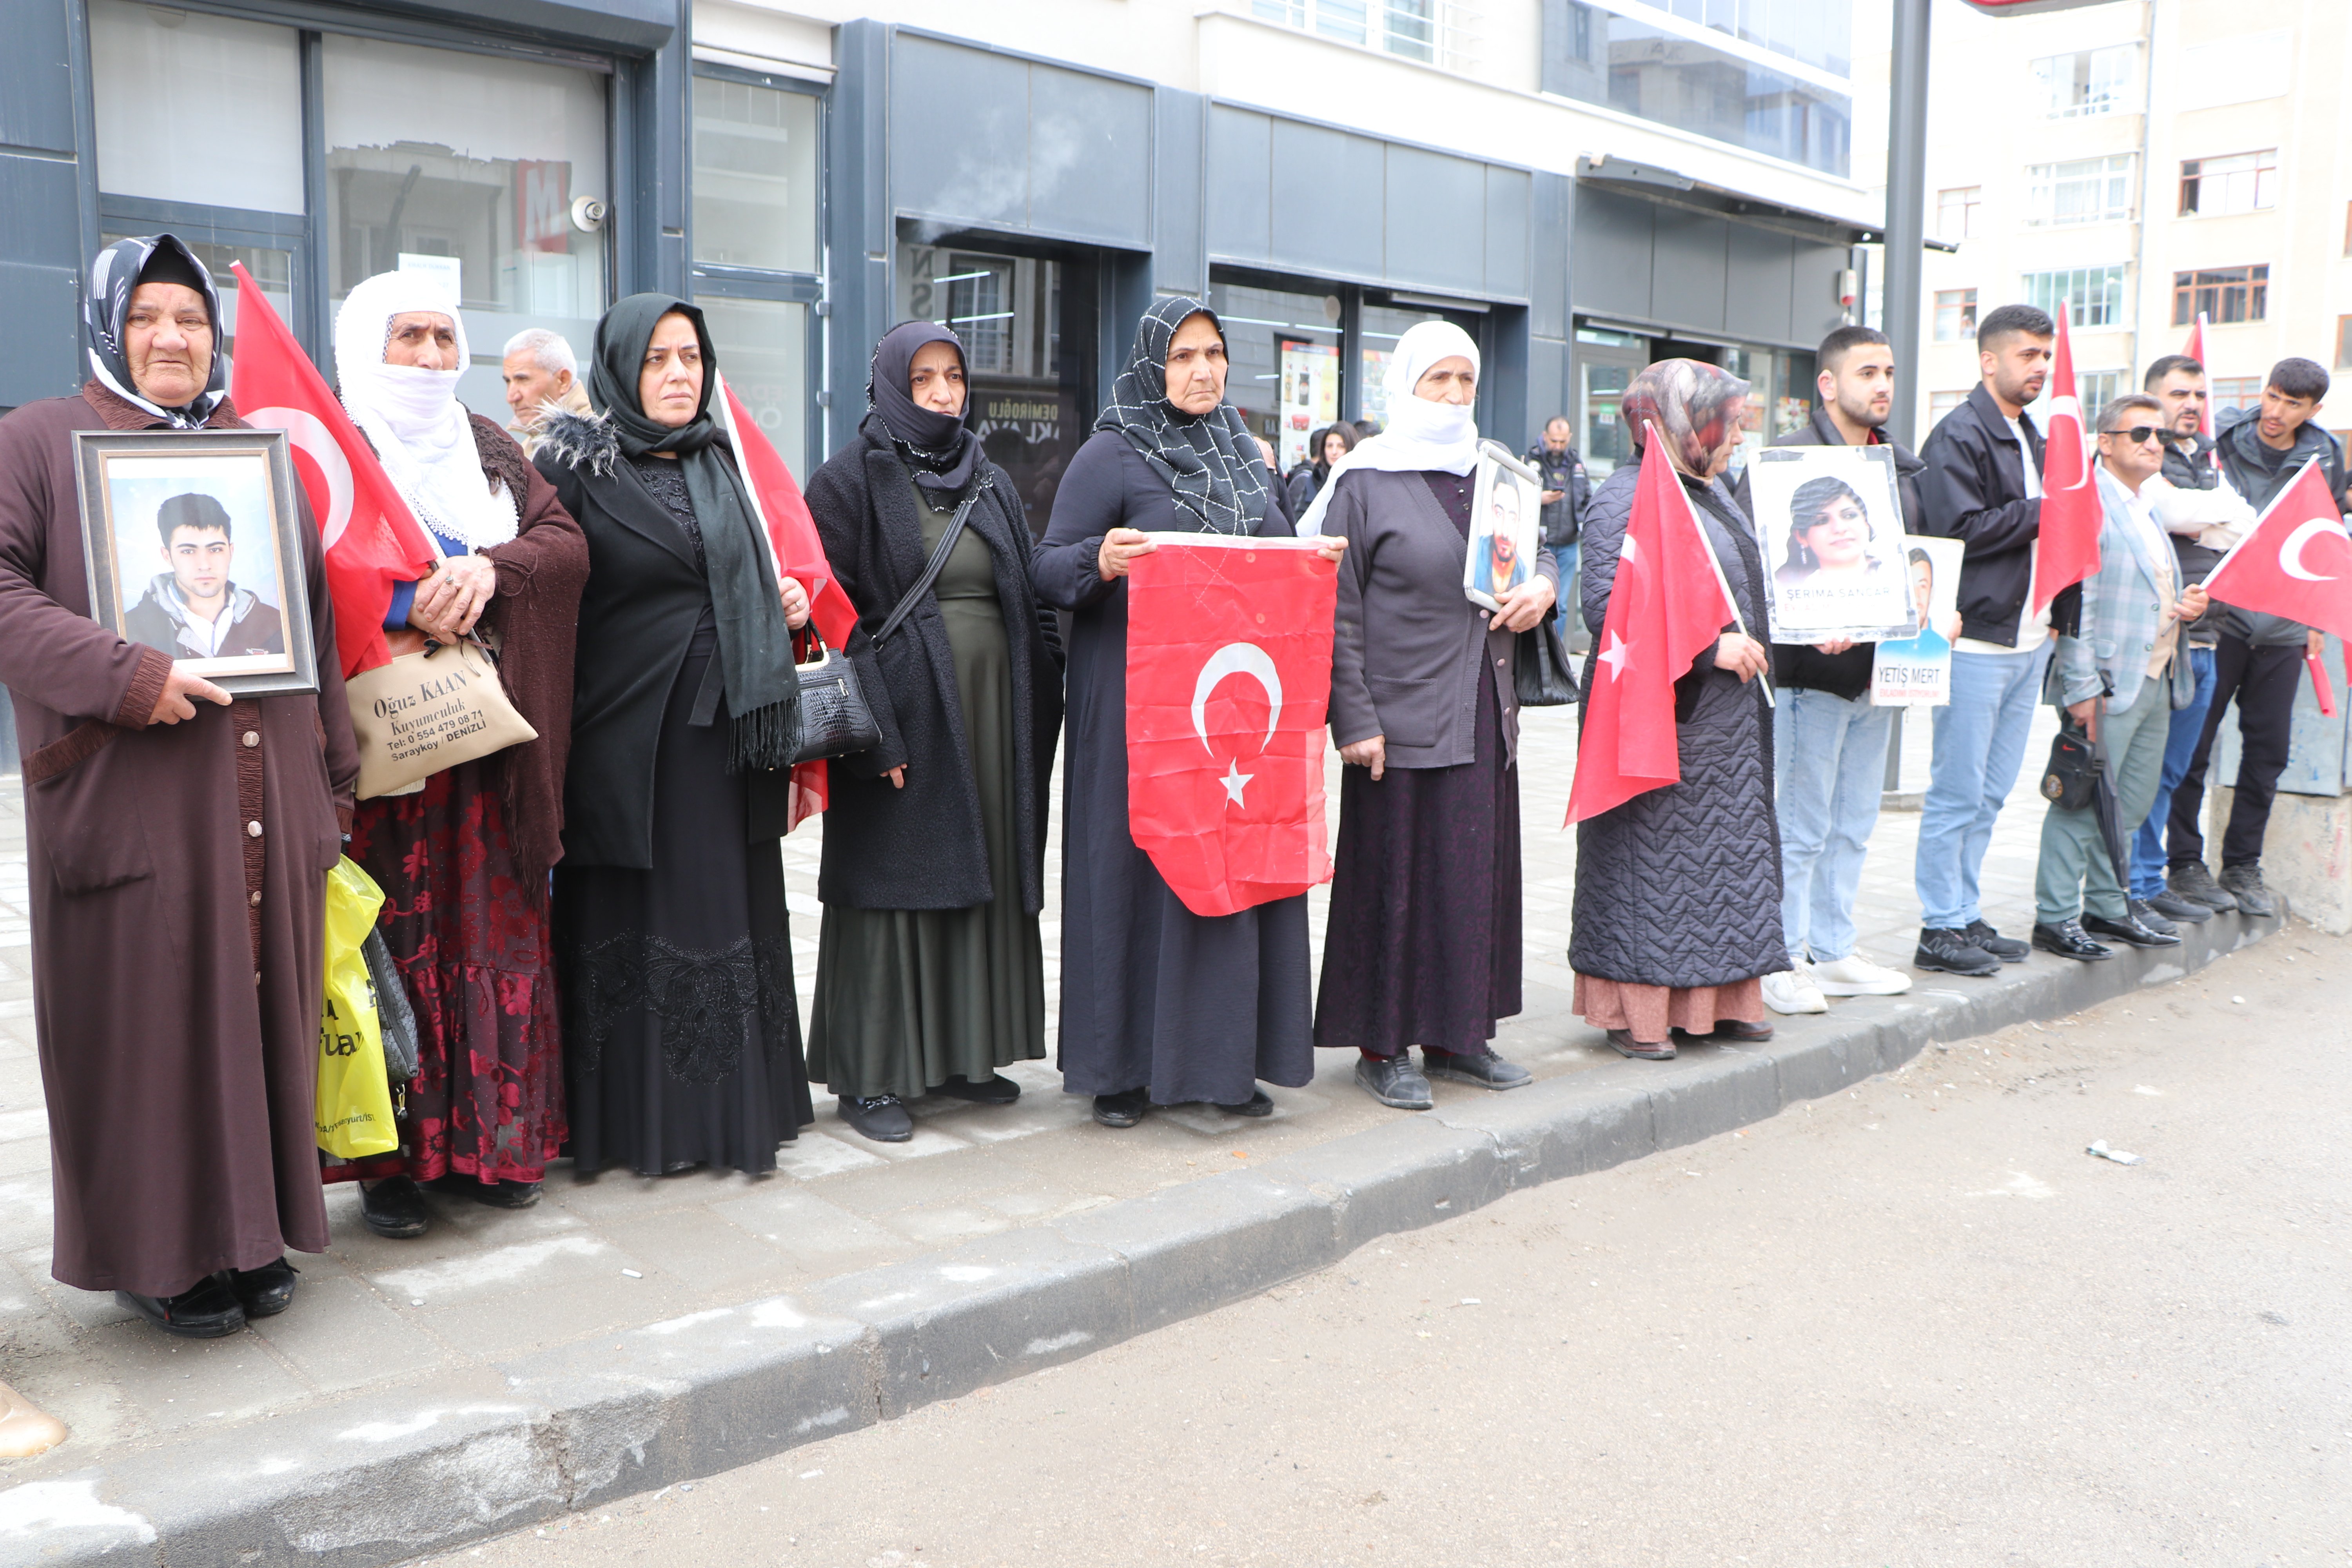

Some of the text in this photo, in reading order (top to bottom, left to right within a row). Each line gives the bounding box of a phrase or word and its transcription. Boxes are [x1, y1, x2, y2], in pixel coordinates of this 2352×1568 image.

[1786, 587, 1890, 601] ŞERİMA SANCAR
[374, 670, 467, 719] Oğuz KAAN
[1878, 664, 1940, 687] YETİŞ MERT
[387, 710, 483, 750] Tel: 0 554 479 08 71
[391, 698, 466, 736] Kuyumculuk
[391, 741, 438, 761] Sarayköy
[446, 719, 486, 742] DENİZLİ
